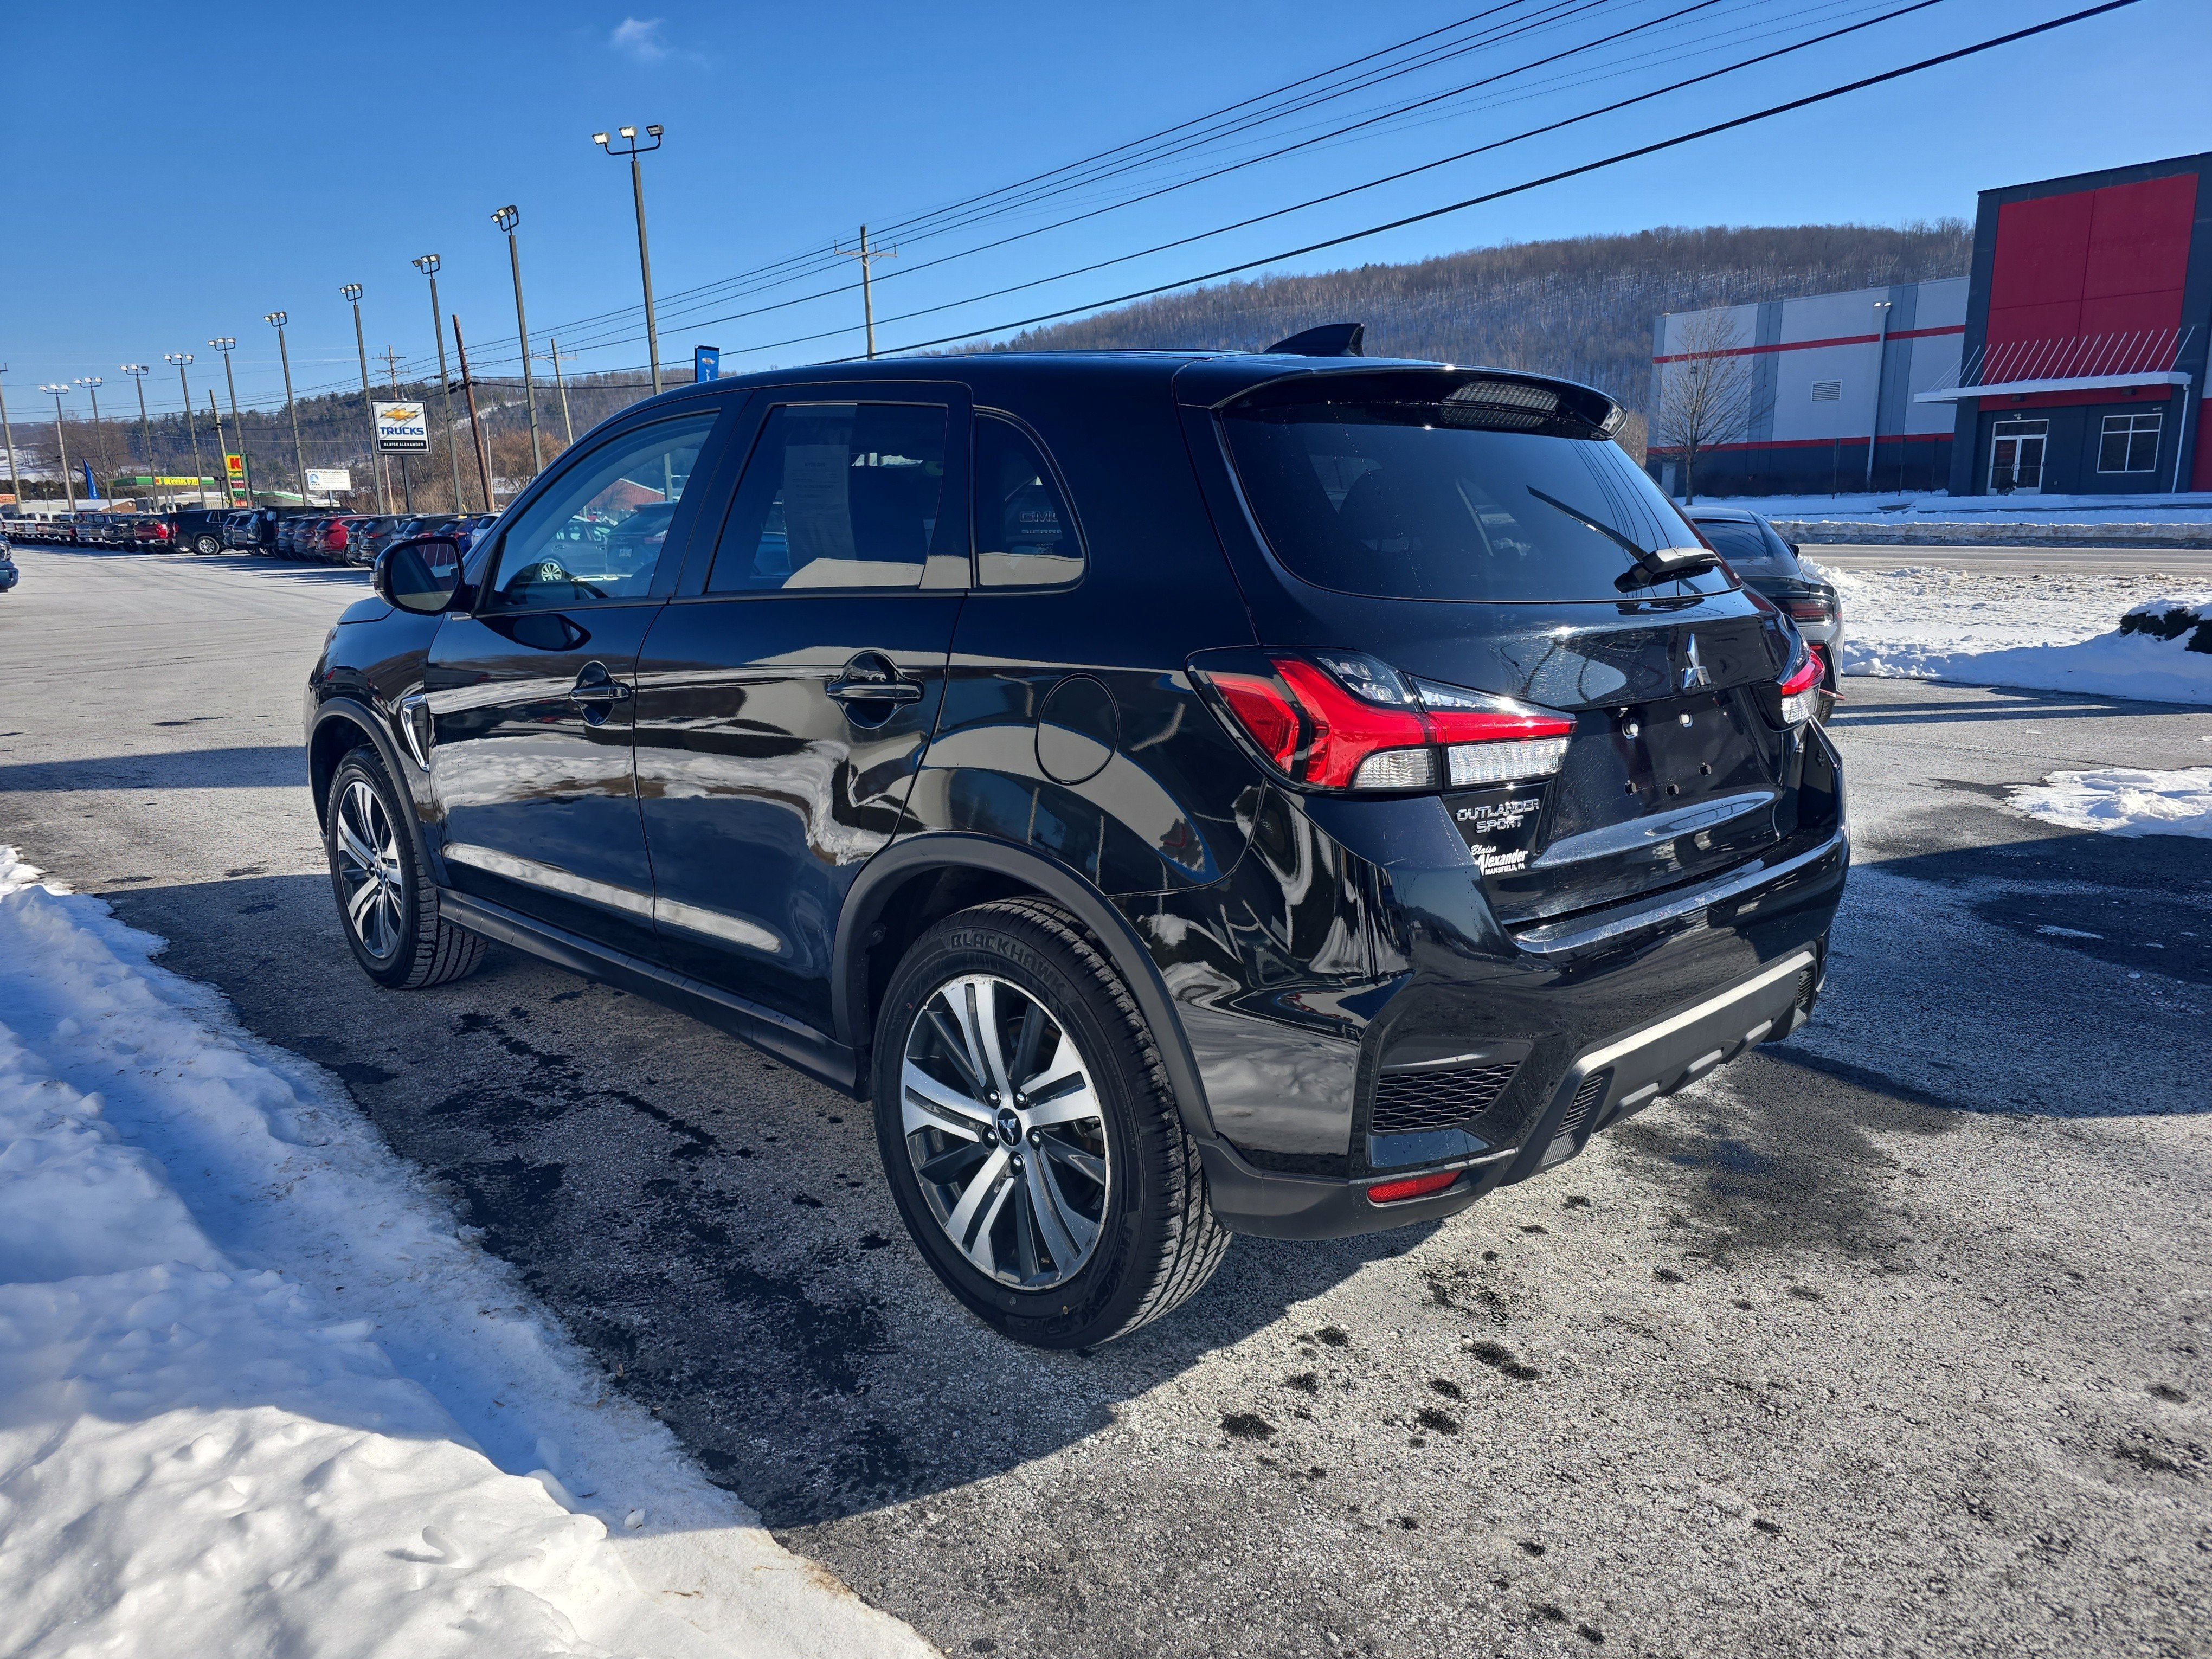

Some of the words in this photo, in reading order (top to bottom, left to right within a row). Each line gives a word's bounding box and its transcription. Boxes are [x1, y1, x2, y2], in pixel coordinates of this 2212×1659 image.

[379, 427, 425, 435] TRUCKS
[229, 458, 241, 469] K
[1456, 798, 1540, 822] OUTLANDER
[1475, 815, 1524, 834] SPORT
[1471, 844, 1496, 856] Blaise
[1474, 849, 1529, 876] Alexander
[1484, 864, 1518, 876] MANSFIELD,
[1518, 862, 1526, 870] PA
[950, 933, 1068, 1001] BLACKHAWK
